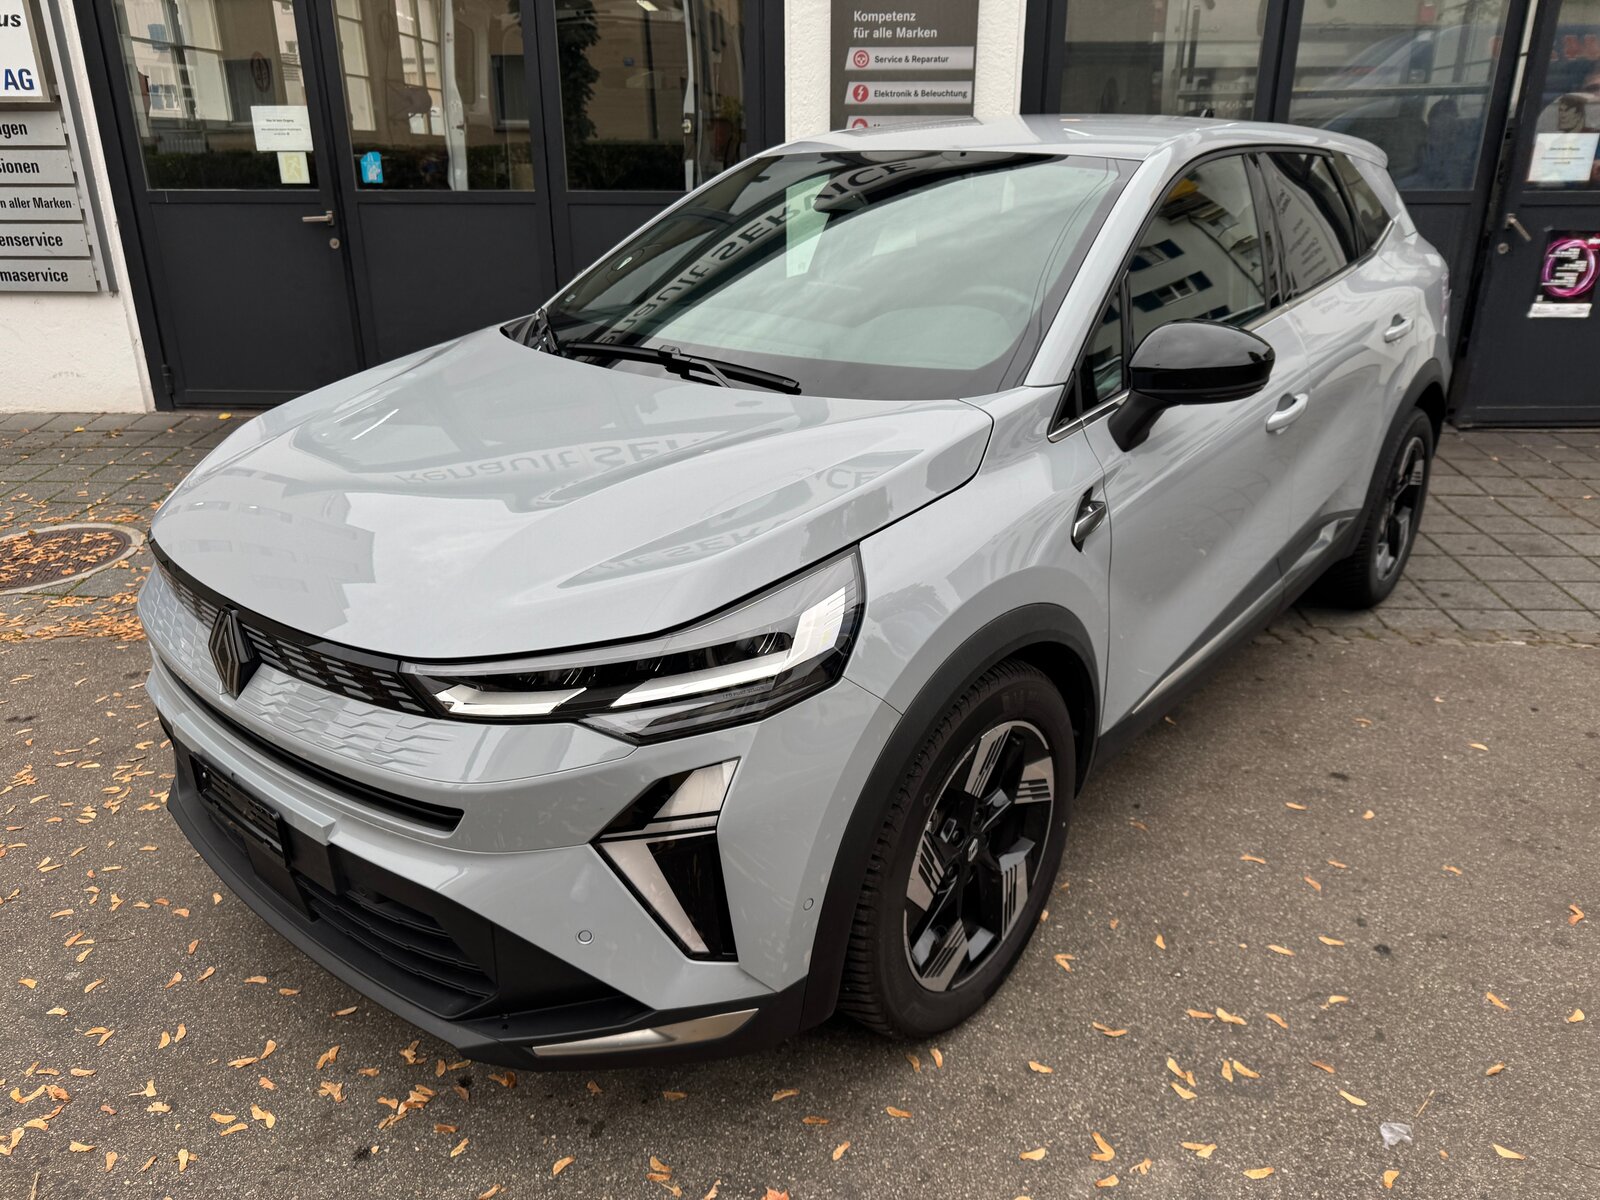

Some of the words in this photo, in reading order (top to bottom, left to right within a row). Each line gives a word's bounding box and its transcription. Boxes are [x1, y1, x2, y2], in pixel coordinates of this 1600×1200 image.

[853, 10, 917, 24] Kompetenz
[853, 27, 870, 38] für
[873, 27, 893, 38] alle
[896, 27, 938, 39] Marken
[874, 55, 903, 64] Service
[904, 55, 910, 63] &
[911, 55, 950, 66] Reparatur
[4, 68, 35, 91] AG
[874, 90, 912, 98] Elektronik
[920, 90, 968, 99] Beleuchtung
[9, 197, 31, 209] aller
[32, 197, 72, 209] Marken
[0, 232, 63, 247] enservice
[0, 267, 69, 282] maservice
